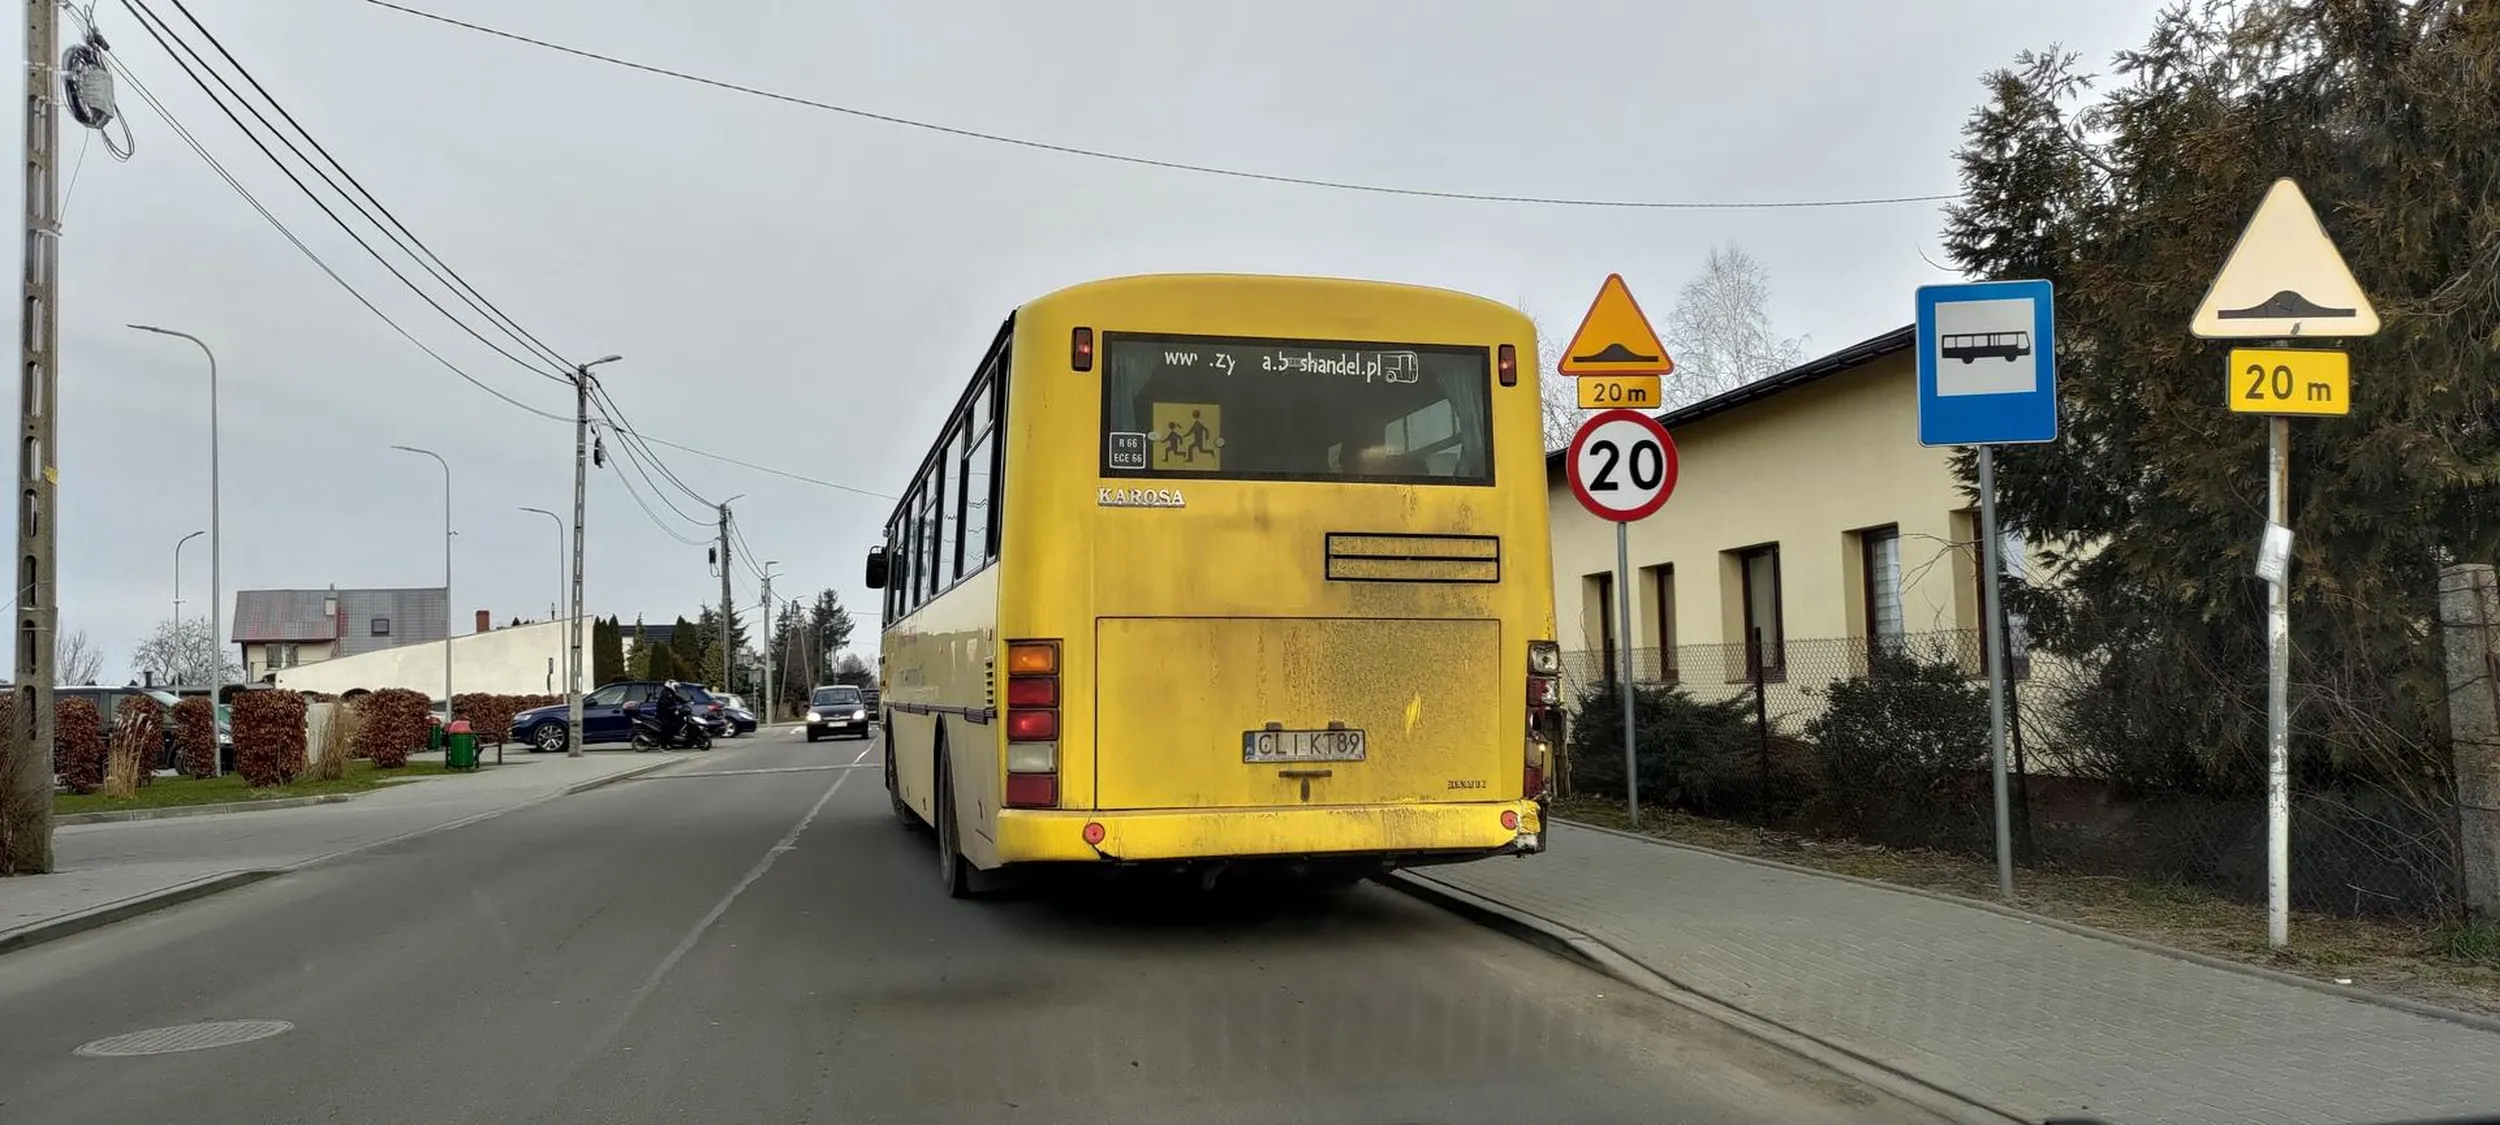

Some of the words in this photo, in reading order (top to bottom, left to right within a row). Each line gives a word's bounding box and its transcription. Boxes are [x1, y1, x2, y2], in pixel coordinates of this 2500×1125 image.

[2245, 363, 2294, 400] 20
[2307, 382, 2331, 401] m
[1593, 383, 1622, 402] 20
[1627, 388, 1646, 402] m
[1119, 438, 1125, 448] R
[1127, 438, 1138, 448] 66
[1113, 453, 1129, 463] ECE
[1132, 453, 1142, 463] 66
[1589, 439, 1664, 491] 20
[1098, 487, 1186, 507] KAROSA
